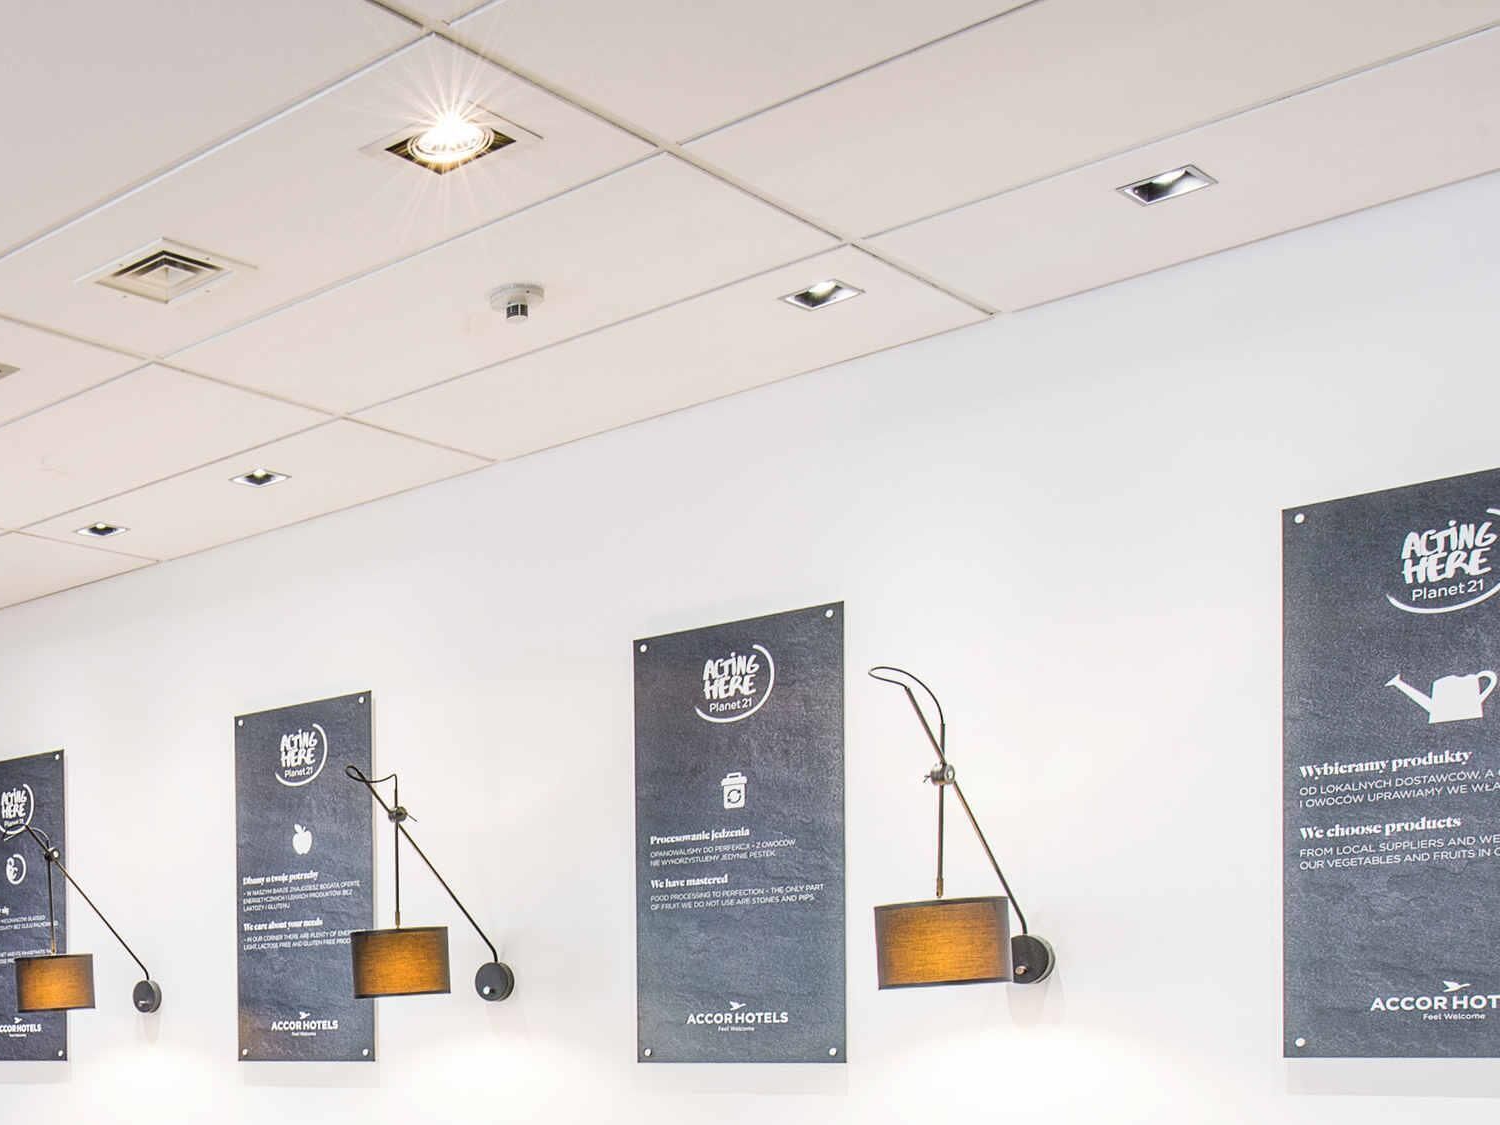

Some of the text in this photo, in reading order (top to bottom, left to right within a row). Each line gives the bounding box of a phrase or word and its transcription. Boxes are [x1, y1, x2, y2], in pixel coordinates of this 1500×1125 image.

[1402, 520, 1498, 560] ACTING
[1401, 547, 1492, 585] HERE
[1412, 578, 1485, 601] Planet 21
[703, 651, 760, 681] ACTING
[703, 673, 757, 700] HERE
[709, 697, 752, 713] Planet 21
[280, 748, 316, 768] HERE
[1299, 749, 1473, 780] Wybieramy produkty
[1299, 786, 1317, 796] OD
[1320, 778, 1391, 795] LOKALNYCH
[1484, 769, 1494, 779] A
[1305, 793, 1365, 808] OWOCÓW
[1367, 786, 1443, 802] UPRAWIAMY
[1446, 784, 1468, 794] WE
[1, 803, 26, 819] HERE
[1299, 816, 1462, 840] We choose products
[1299, 846, 1333, 857] FROM
[1336, 844, 1376, 856] LOCAL
[1379, 838, 1445, 852] SUPPLIERS
[1447, 836, 1476, 847] AND
[1299, 860, 1325, 870] OUR
[1326, 854, 1402, 868] VEGETABLES
[1403, 852, 1430, 863] AND
[1433, 849, 1476, 861] FRUITS
[1478, 848, 1491, 857] IN
[650, 873, 728, 889] We have mastered
[650, 894, 669, 902] FOOD
[712, 890, 721, 898] TO
[771, 886, 784, 894] THE
[785, 884, 804, 893] ONLY
[805, 883, 824, 891] PART
[681, 901, 692, 909] WE
[694, 900, 704, 908] DO
[705, 899, 719, 907] NOT
[752, 896, 780, 905] STONES
[781, 894, 797, 902] AND
[1443, 1012, 1486, 1020] Welcome
